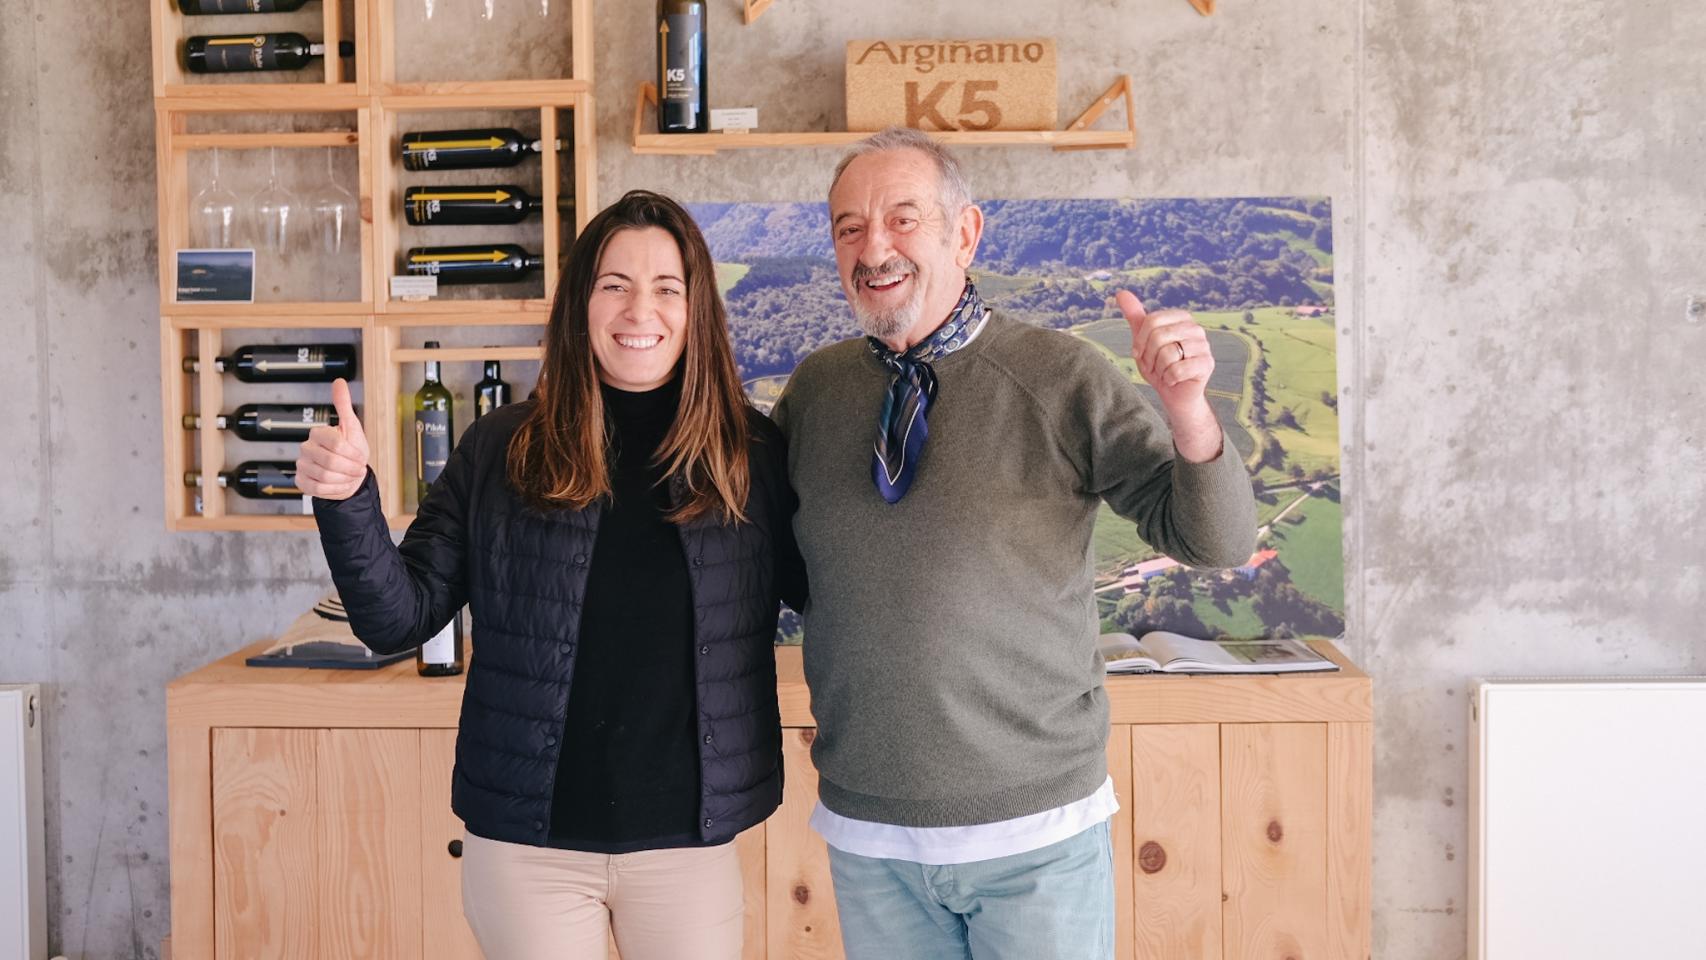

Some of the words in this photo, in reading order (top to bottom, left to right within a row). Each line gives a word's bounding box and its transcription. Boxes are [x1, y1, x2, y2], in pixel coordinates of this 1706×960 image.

[855, 40, 1044, 73] Argiñano
[667, 69, 686, 82] K5
[904, 80, 1002, 131] K5
[428, 149, 437, 161] K5
[431, 200, 440, 213] K5
[298, 347, 309, 362] K5
[303, 407, 314, 423] K5
